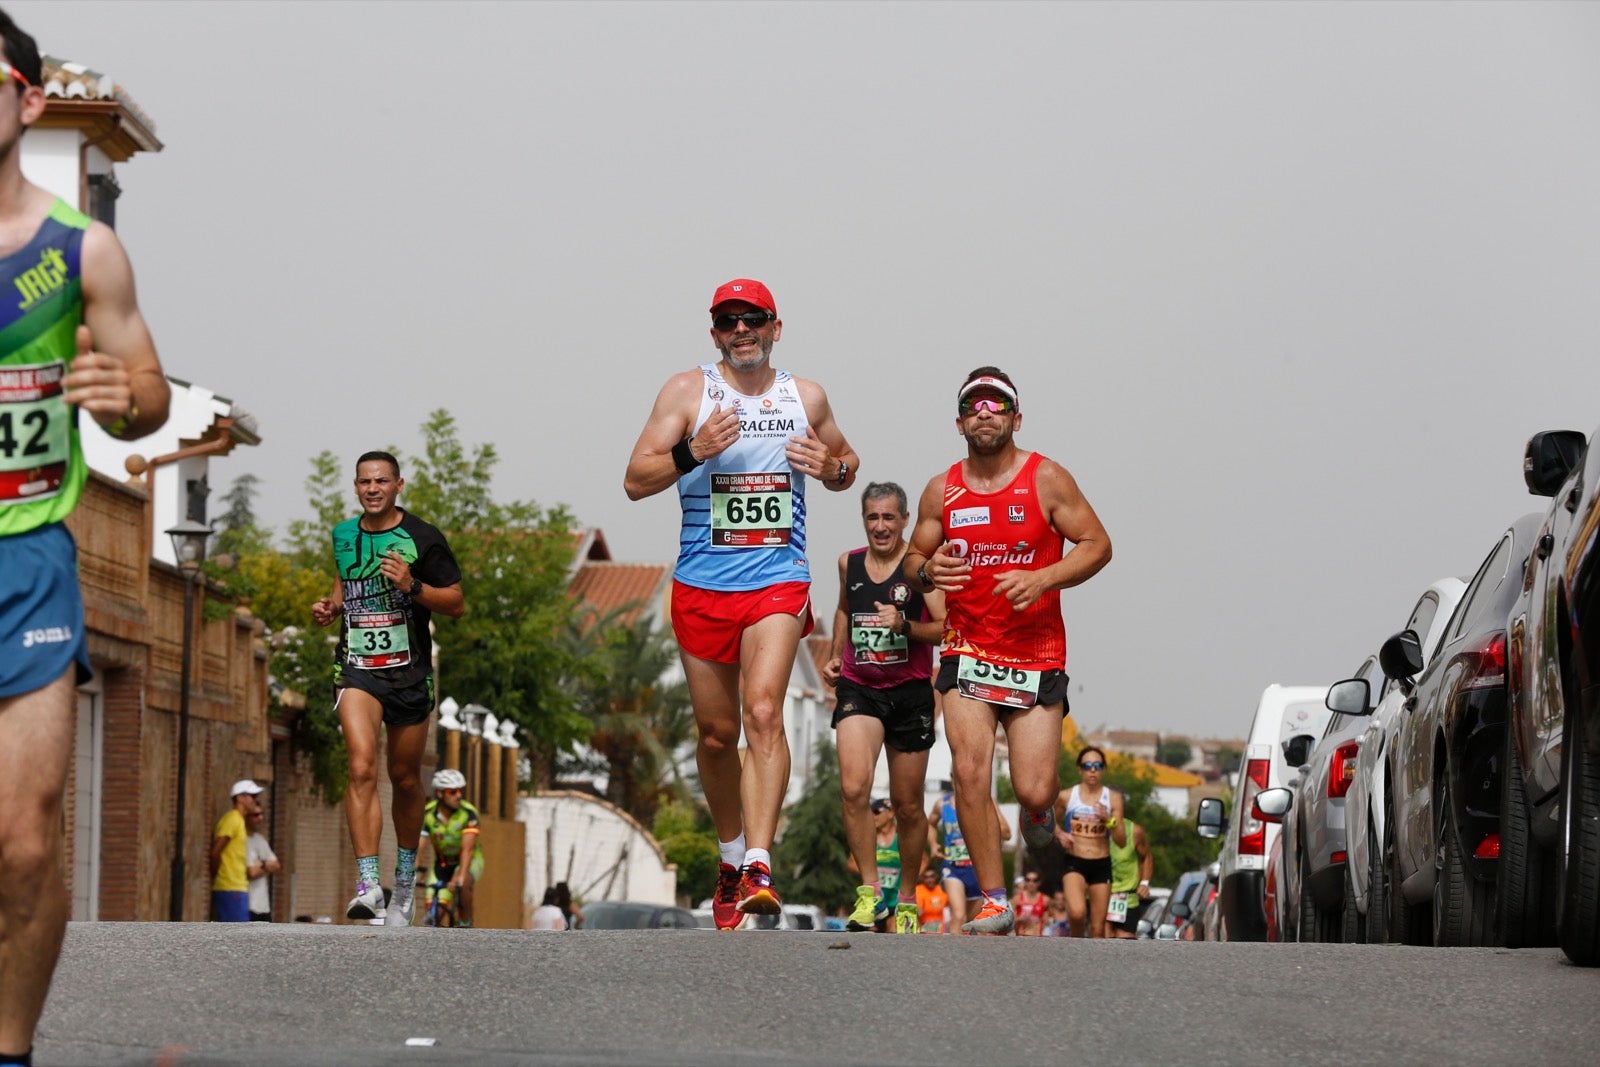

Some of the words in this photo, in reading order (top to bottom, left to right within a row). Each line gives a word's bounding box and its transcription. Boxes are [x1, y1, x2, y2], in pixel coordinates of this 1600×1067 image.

[730, 476, 745, 485] GRAN
[745, 475, 763, 484] PREMIO
[765, 475, 771, 484] DE
[772, 475, 787, 484] FONDO
[726, 496, 781, 524] 656
[1010, 506, 1013, 515] I
[973, 542, 1007, 552] Clínicas
[363, 630, 392, 651] 33
[973, 659, 1028, 685] 596
